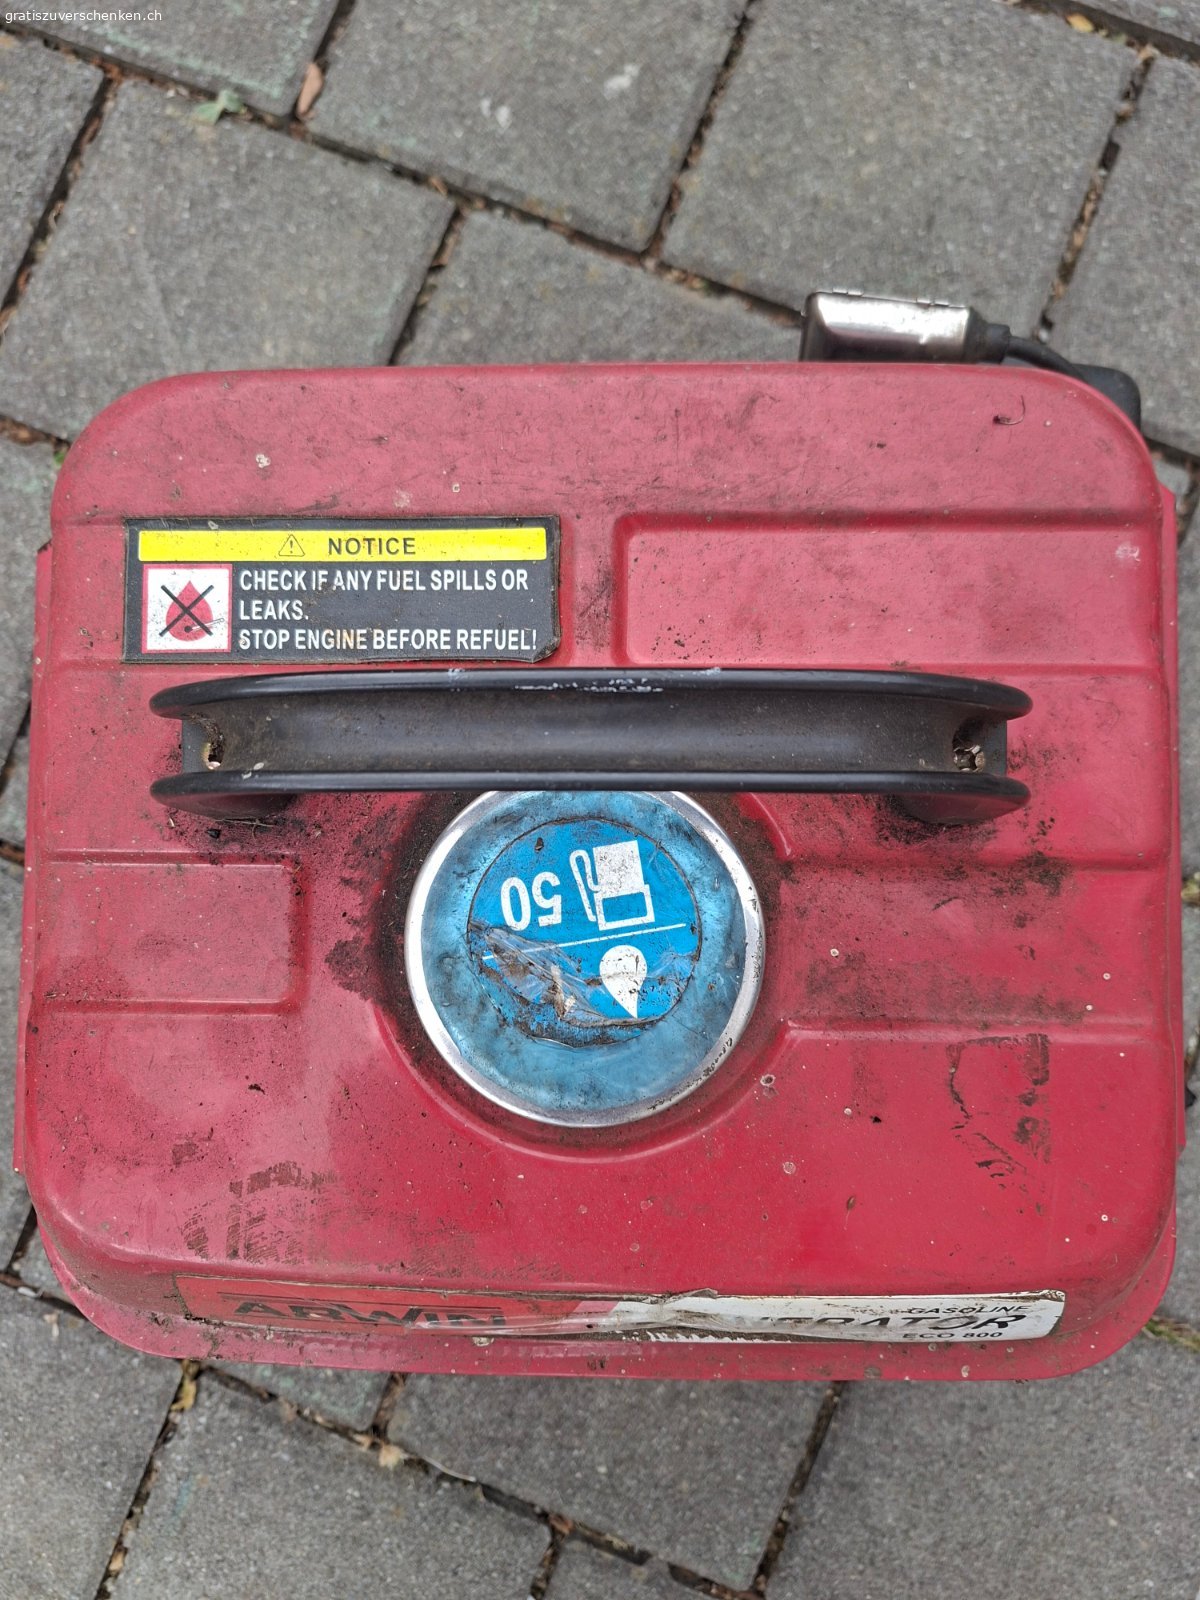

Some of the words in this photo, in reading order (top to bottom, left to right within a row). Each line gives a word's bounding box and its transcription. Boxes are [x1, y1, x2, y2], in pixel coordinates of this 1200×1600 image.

[328, 537, 416, 556] NOTICE
[240, 570, 305, 591] CHECK
[312, 570, 328, 591] IF
[333, 570, 372, 591] ANY
[376, 570, 426, 591] FUEL
[430, 569, 497, 591] SPILLS
[501, 569, 529, 590] OR
[240, 600, 309, 621] LEAKS.
[239, 629, 290, 651] STOP
[295, 629, 367, 651] ENGINE
[373, 629, 452, 650] BEFORE
[457, 629, 538, 650] REFUEL!
[500, 871, 562, 931] 50
[961, 1331, 1003, 1339] 800
